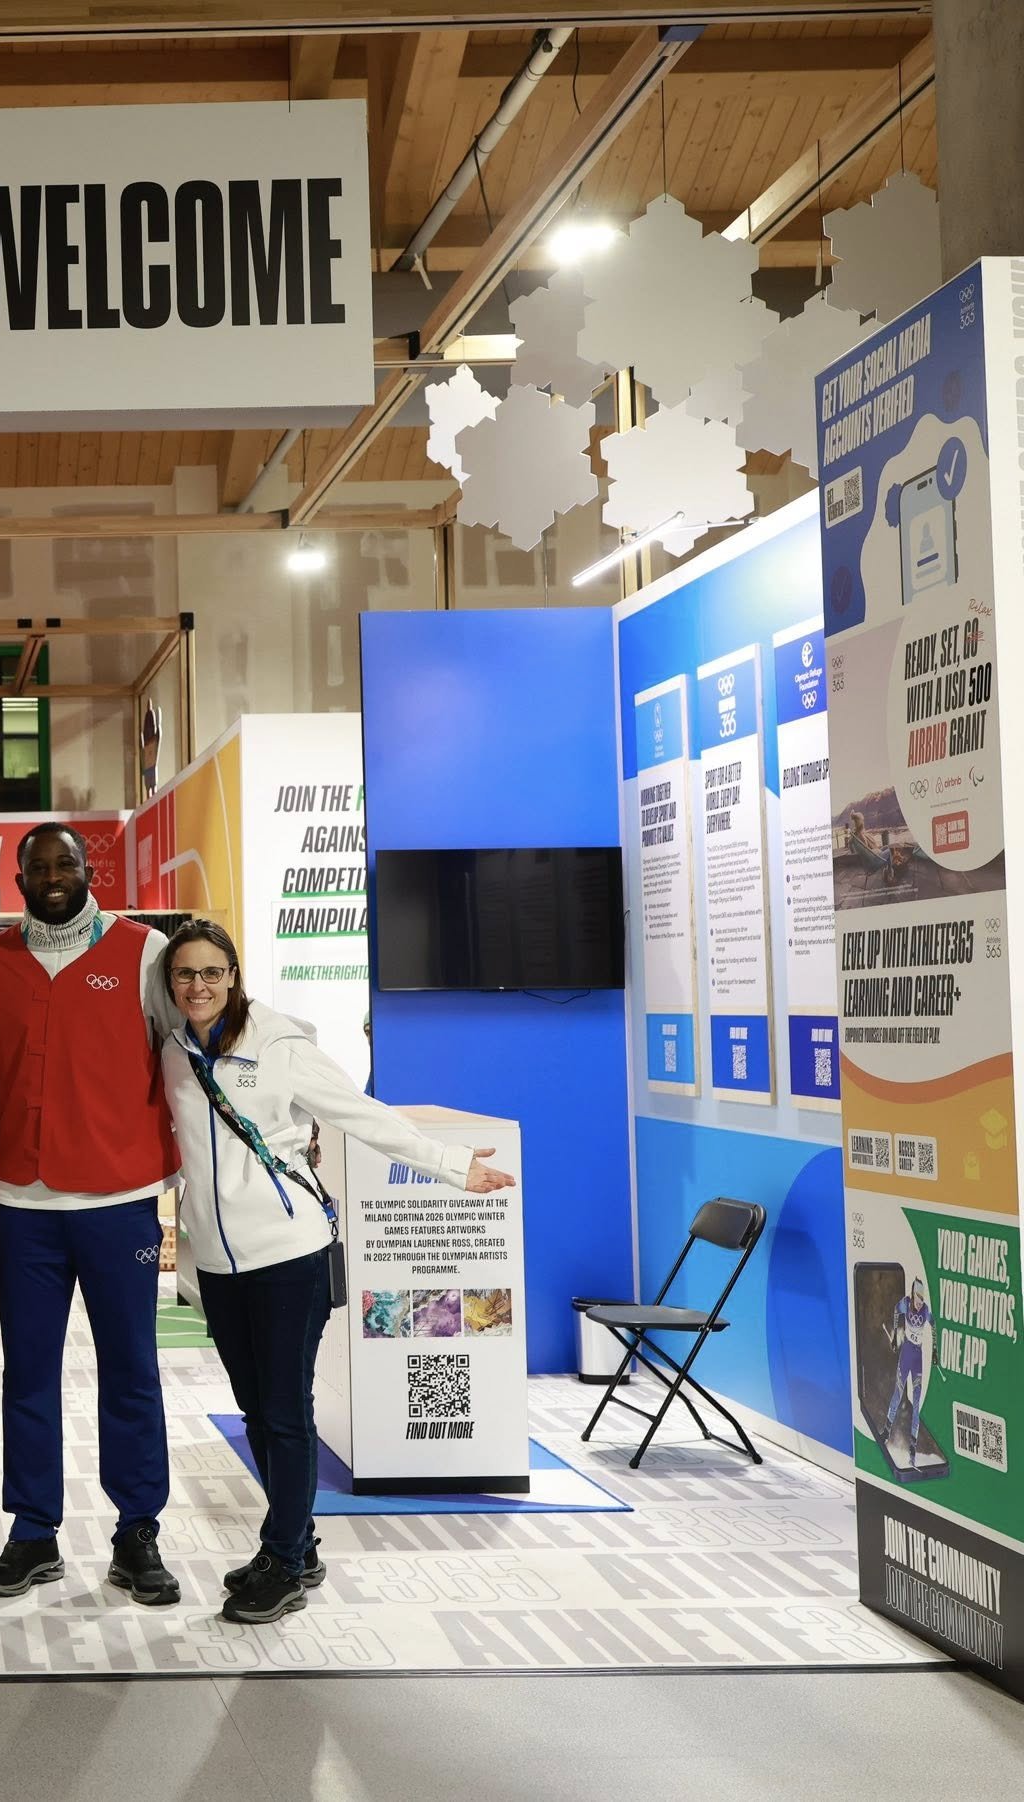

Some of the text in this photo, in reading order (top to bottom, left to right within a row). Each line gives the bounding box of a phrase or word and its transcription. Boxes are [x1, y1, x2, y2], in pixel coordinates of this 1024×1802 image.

[959, 313, 976, 330] 365
[822, 313, 931, 423] GET YOUR SOCIAL MEDIA
[823, 374, 915, 467] ACCOUNTS VERIFIED
[968, 598, 993, 618] Relax
[904, 617, 979, 681] READY, SET, GO
[794, 667, 823, 684] Olympic Refuge
[799, 679, 820, 692] Foundation
[906, 662, 993, 724] WITH A USD 500
[907, 709, 987, 769] AIRBNB GRANT
[944, 776, 962, 789] airbnb
[274, 785, 316, 812] JOIN
[320, 785, 353, 812] THE
[301, 826, 369, 853] AGAINS
[90, 870, 116, 888] 65
[283, 867, 369, 894] COMPETIT
[278, 911, 370, 936] MANIPULA
[842, 919, 974, 971] LEVEL UP WITH ATHLETE365
[986, 945, 1002, 959] 365
[281, 965, 371, 985] #MAKETHERIGHTD
[844, 973, 962, 1018] LEARNING AND CAREER+
[236, 1079, 256, 1088] 365
[388, 1163, 409, 1184] DID
[360, 1198, 509, 1210] THE OLYMPIC SOLIDARITY GIVEAWAY AT THE
[364, 1212, 506, 1222] MILANO CORTINA 2026 OLYMPIC WINTER
[384, 1225, 486, 1235] GAMES FEATURES ARTWORKS
[366, 1238, 505, 1249] BY OLYMPIAN LAURENNE ROSS, CREATED
[364, 1251, 508, 1262] IN 2022 THROUGH THE OLYMPIAN ARTISTS
[937, 1228, 1010, 1290] YOUR GAMES,
[411, 1265, 460, 1274] PROGRAMME.
[939, 1277, 1018, 1345] YOUR PHOTOS,
[940, 1328, 988, 1380] ONE APP
[406, 1421, 475, 1440] FIND OUT MORE
[956, 1426, 981, 1455] THE APP
[884, 1514, 1001, 1616] JOIN THE COMMUNITY
[886, 1563, 1004, 1670] JOIN THE COMMUNITY
